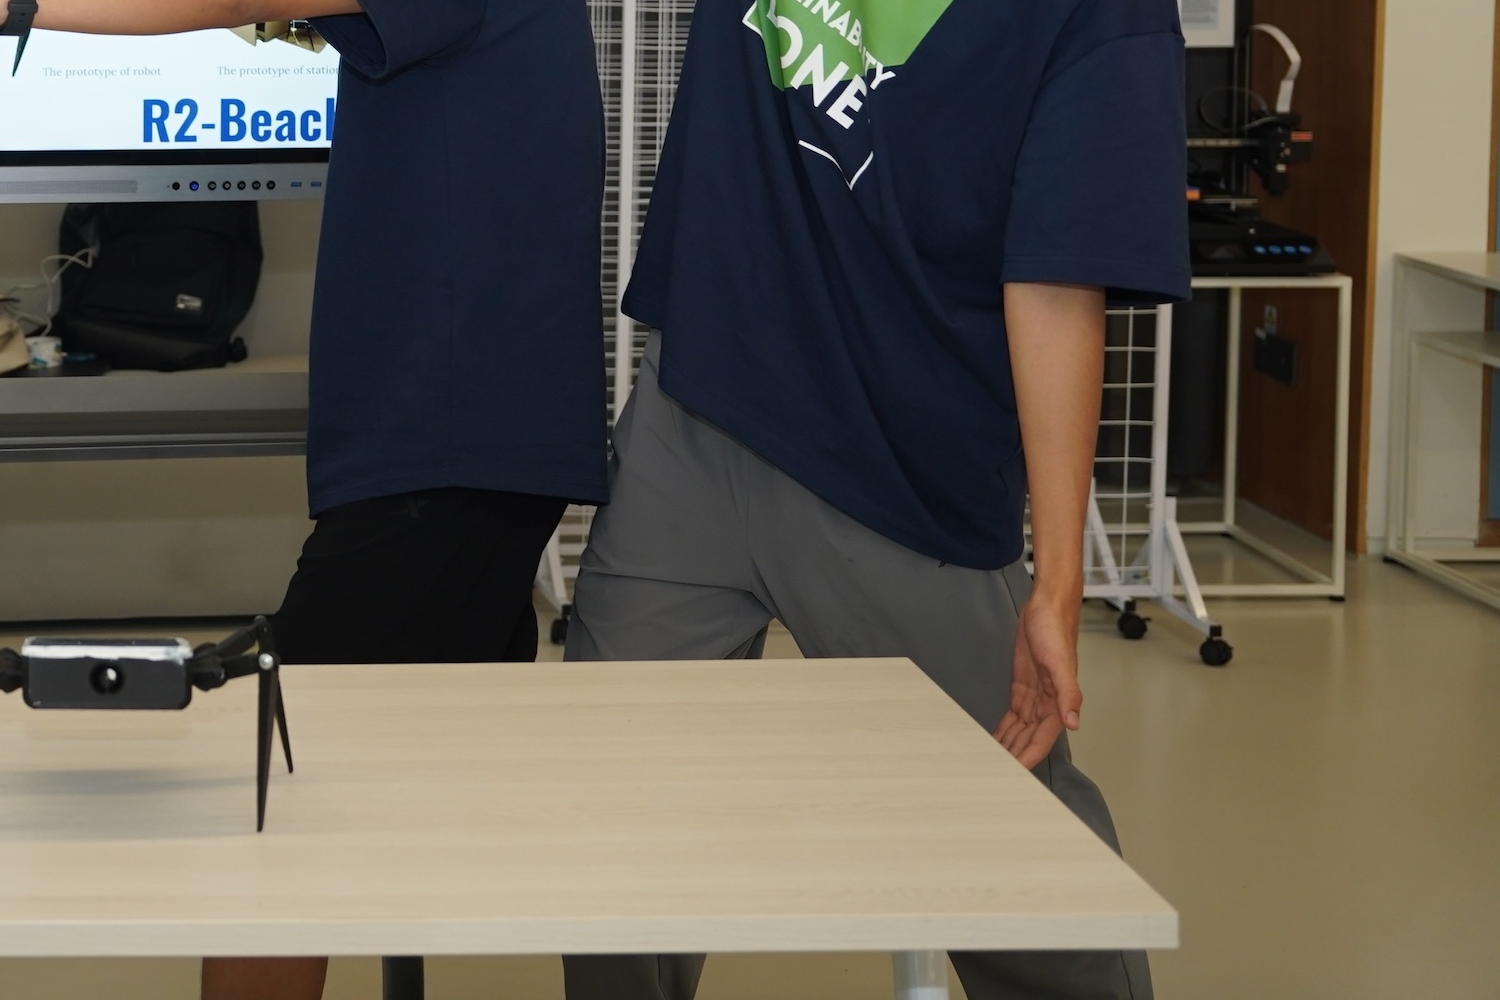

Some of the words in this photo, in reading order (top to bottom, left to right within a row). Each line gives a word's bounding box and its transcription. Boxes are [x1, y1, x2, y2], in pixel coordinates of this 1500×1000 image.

[44, 67, 62, 77] The
[65, 68, 117, 79] prototype
[120, 66, 131, 76] of
[133, 66, 161, 76] robot
[218, 66, 237, 75] The
[239, 67, 291, 78] prototype
[293, 65, 304, 75] of
